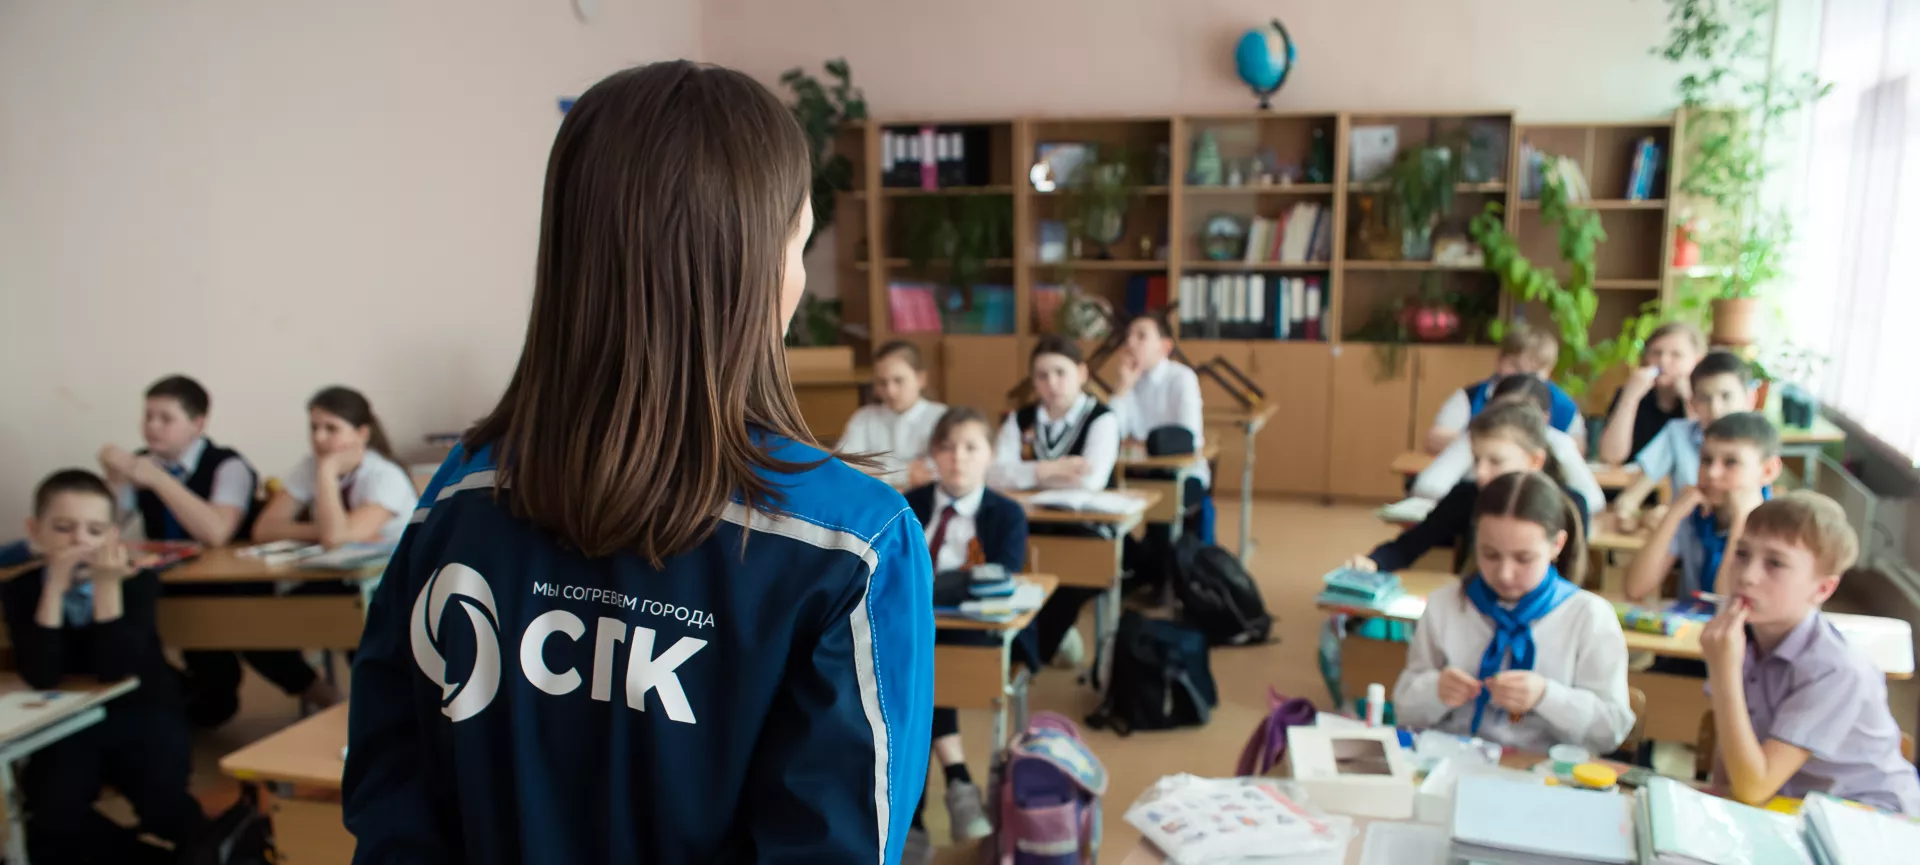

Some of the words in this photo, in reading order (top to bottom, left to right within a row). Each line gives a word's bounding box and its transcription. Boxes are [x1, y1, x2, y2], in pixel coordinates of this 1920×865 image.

[533, 581, 559, 597] МЫ
[563, 585, 637, 610] СОГРЕВЕМ
[641, 599, 715, 628] ГОРОДА
[520, 609, 708, 724] СГК
